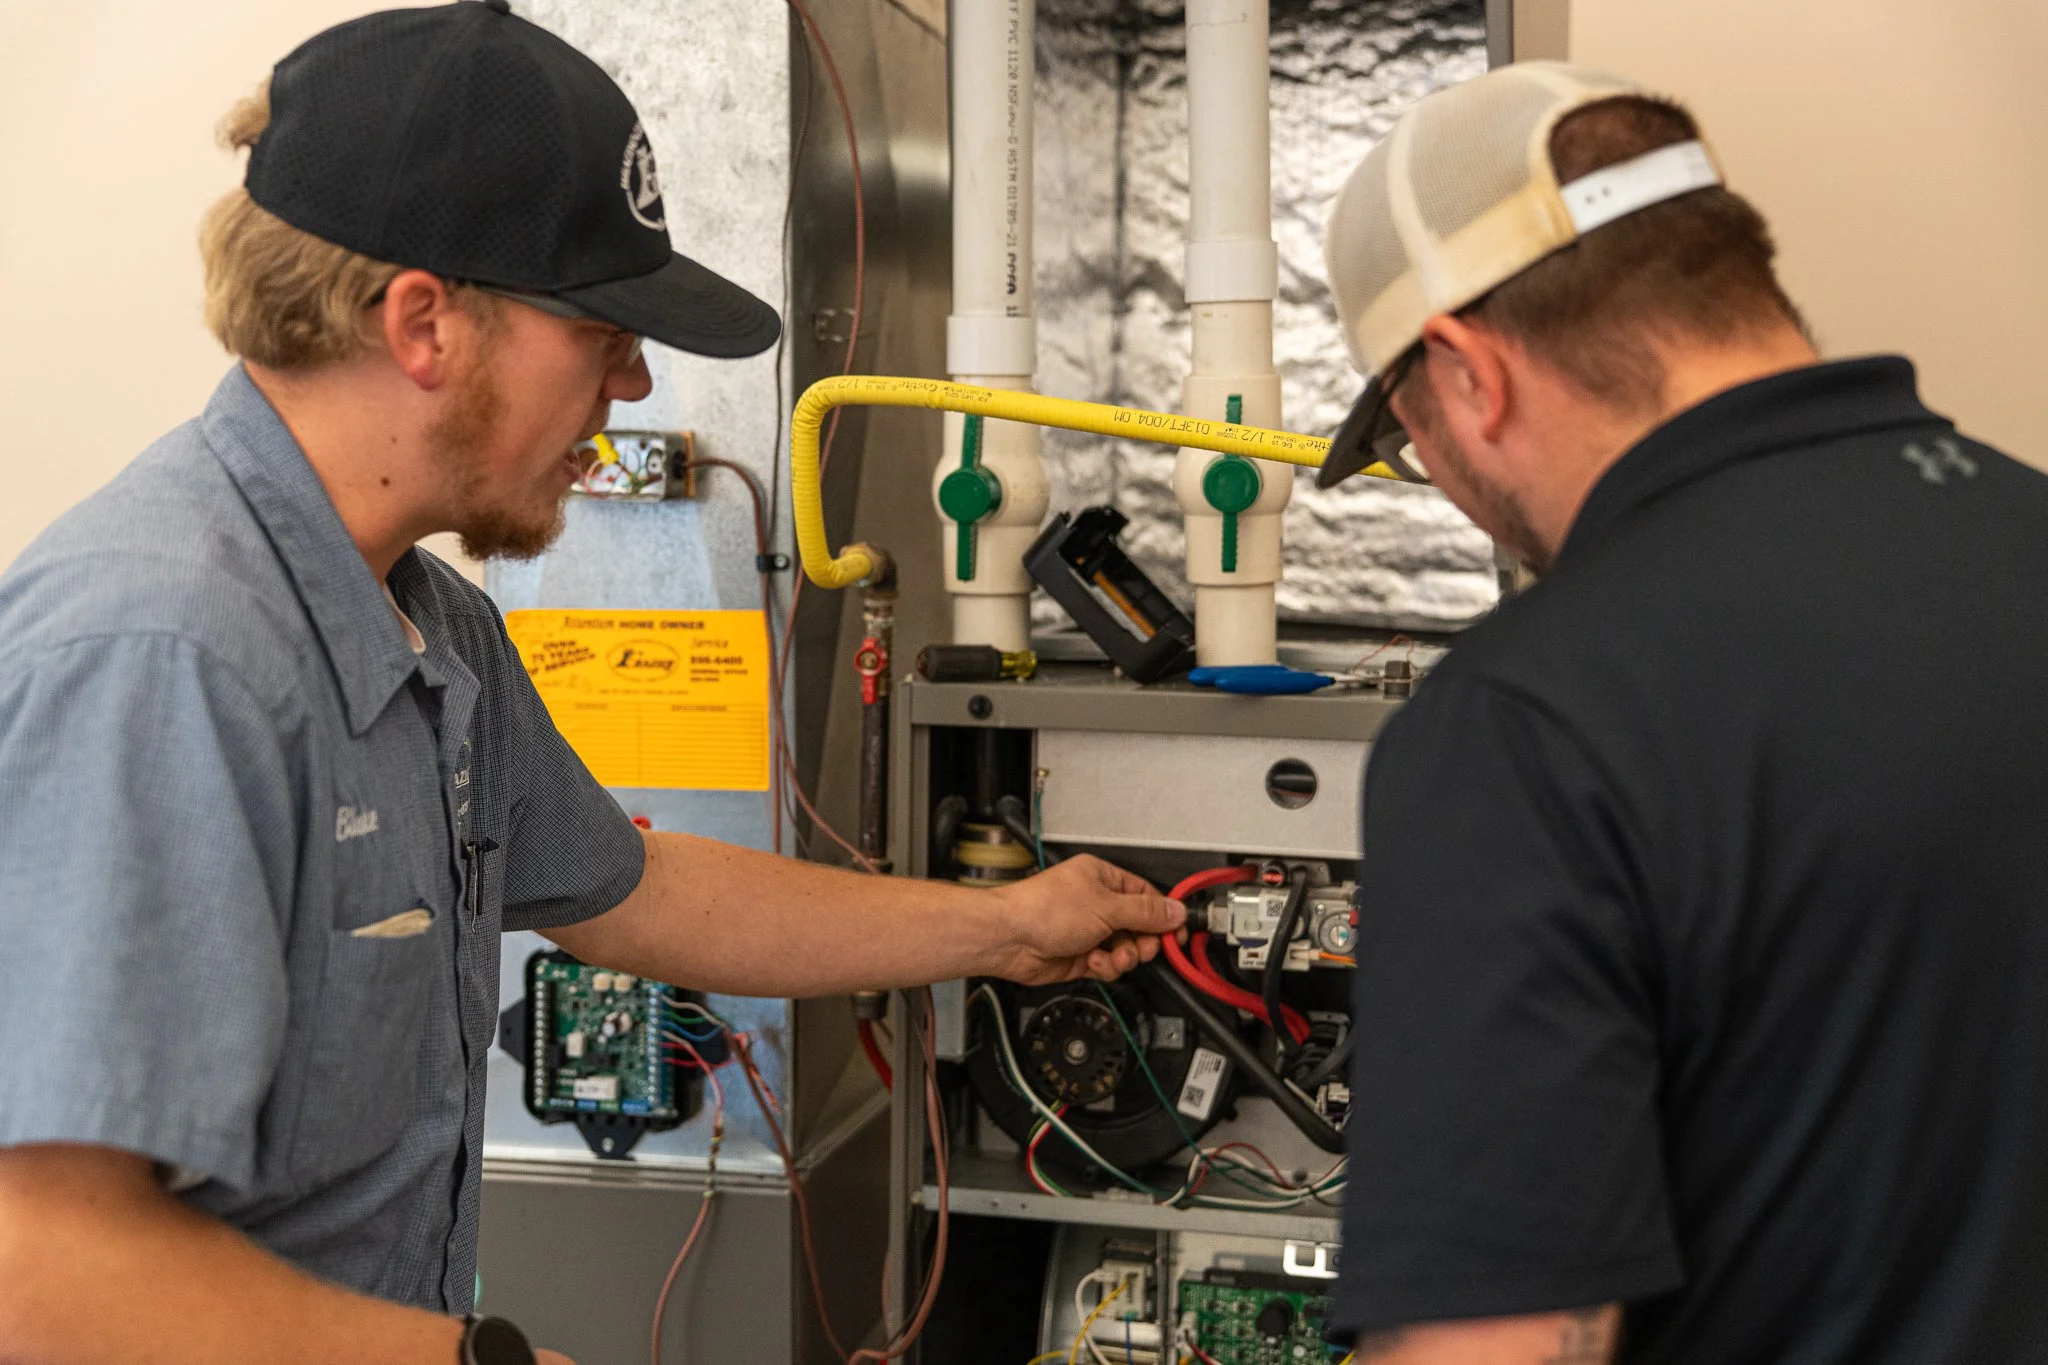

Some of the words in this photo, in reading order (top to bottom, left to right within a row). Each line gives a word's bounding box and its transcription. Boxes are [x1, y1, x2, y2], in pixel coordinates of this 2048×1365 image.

[1007, 20, 1018, 44] PVC
[1007, 50, 1018, 80] 1120
[1240, 429, 1265, 443] 1/2
[659, 620, 705, 630] OWNER
